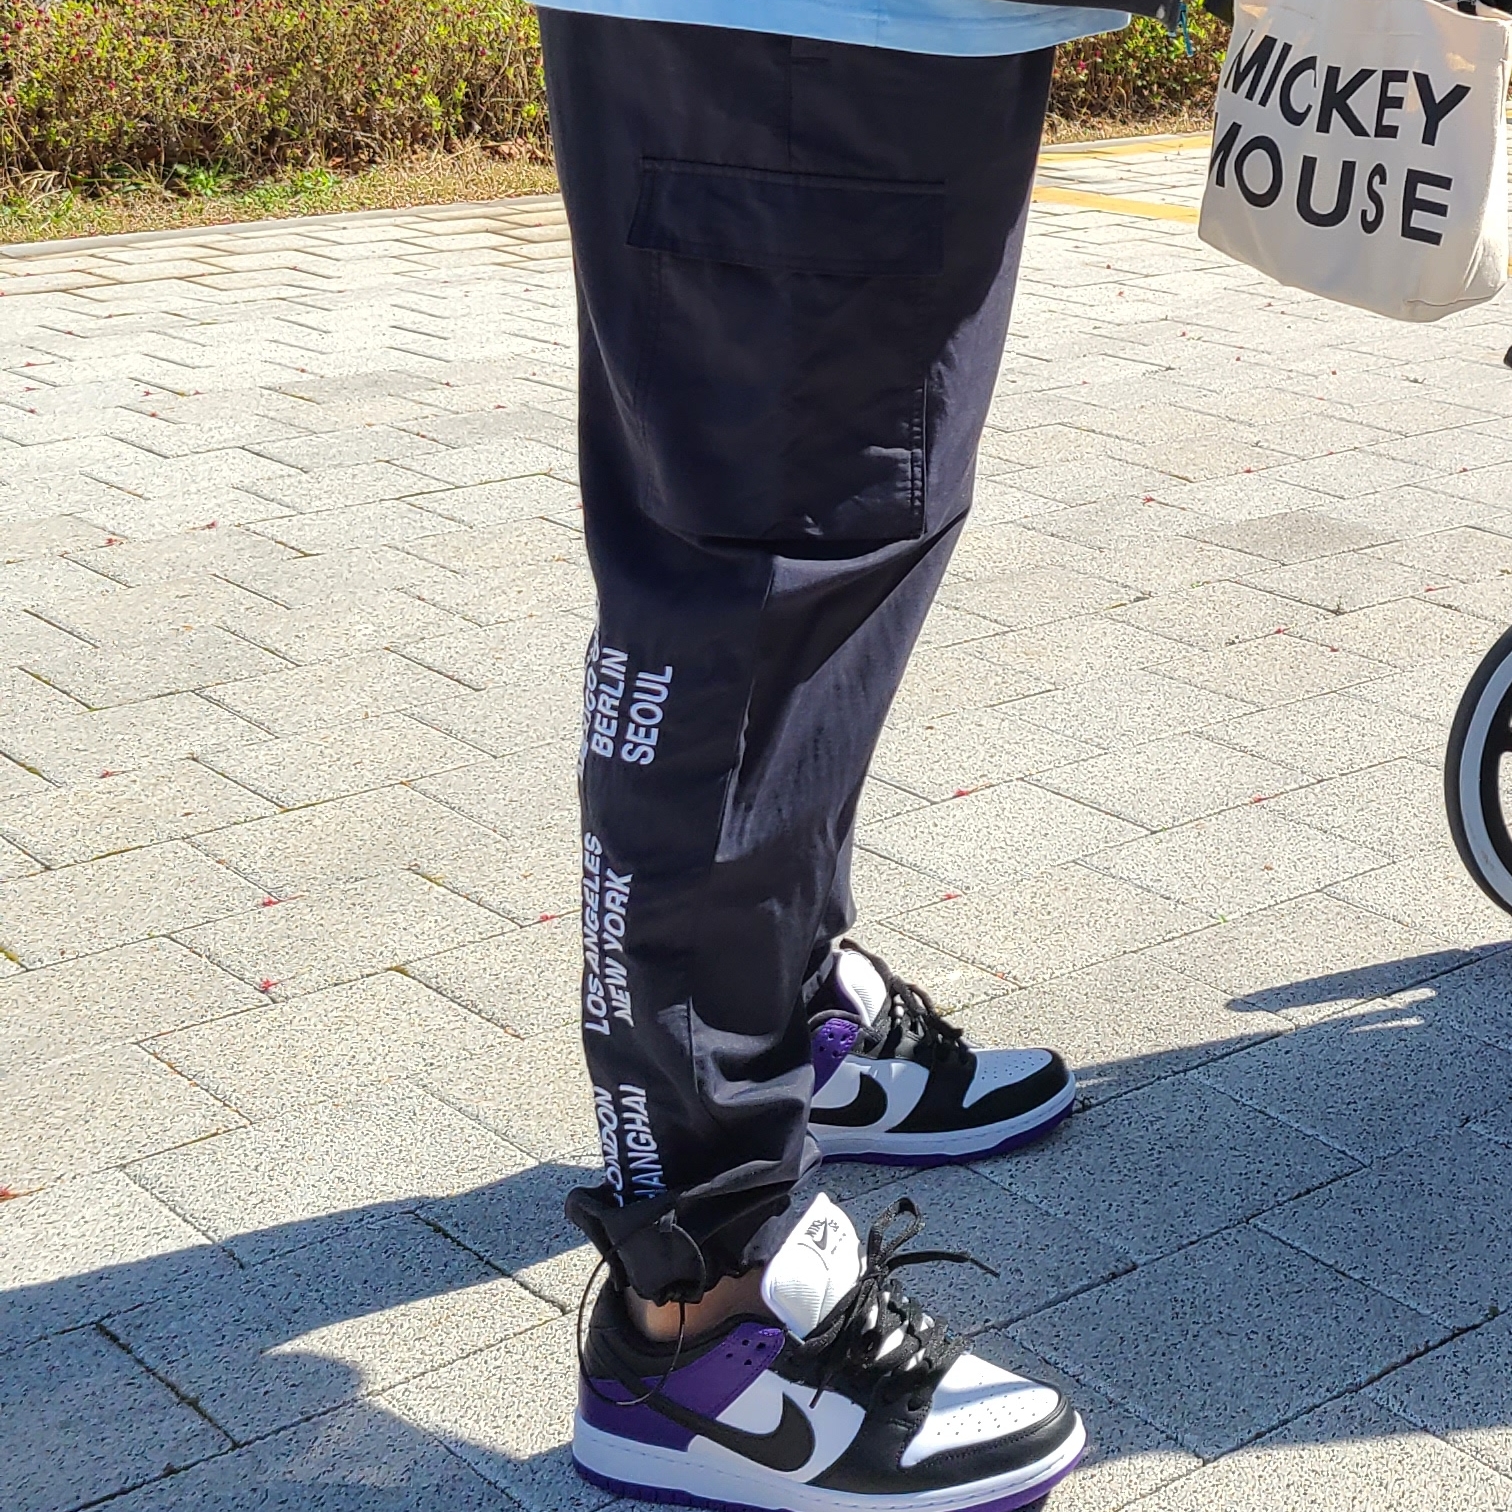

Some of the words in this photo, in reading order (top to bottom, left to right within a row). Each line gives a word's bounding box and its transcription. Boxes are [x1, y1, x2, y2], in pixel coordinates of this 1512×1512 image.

[1223, 29, 1472, 147] MICKEY
[1208, 111, 1454, 247] MOUSE
[590, 647, 629, 758] BERLIN
[620, 665, 673, 766] SEOUL
[582, 832, 604, 976] ANGELES
[603, 868, 634, 953] YORK
[585, 975, 611, 1036] LOS
[605, 957, 635, 1029] NEW
[619, 1084, 667, 1199] ANGHAI
